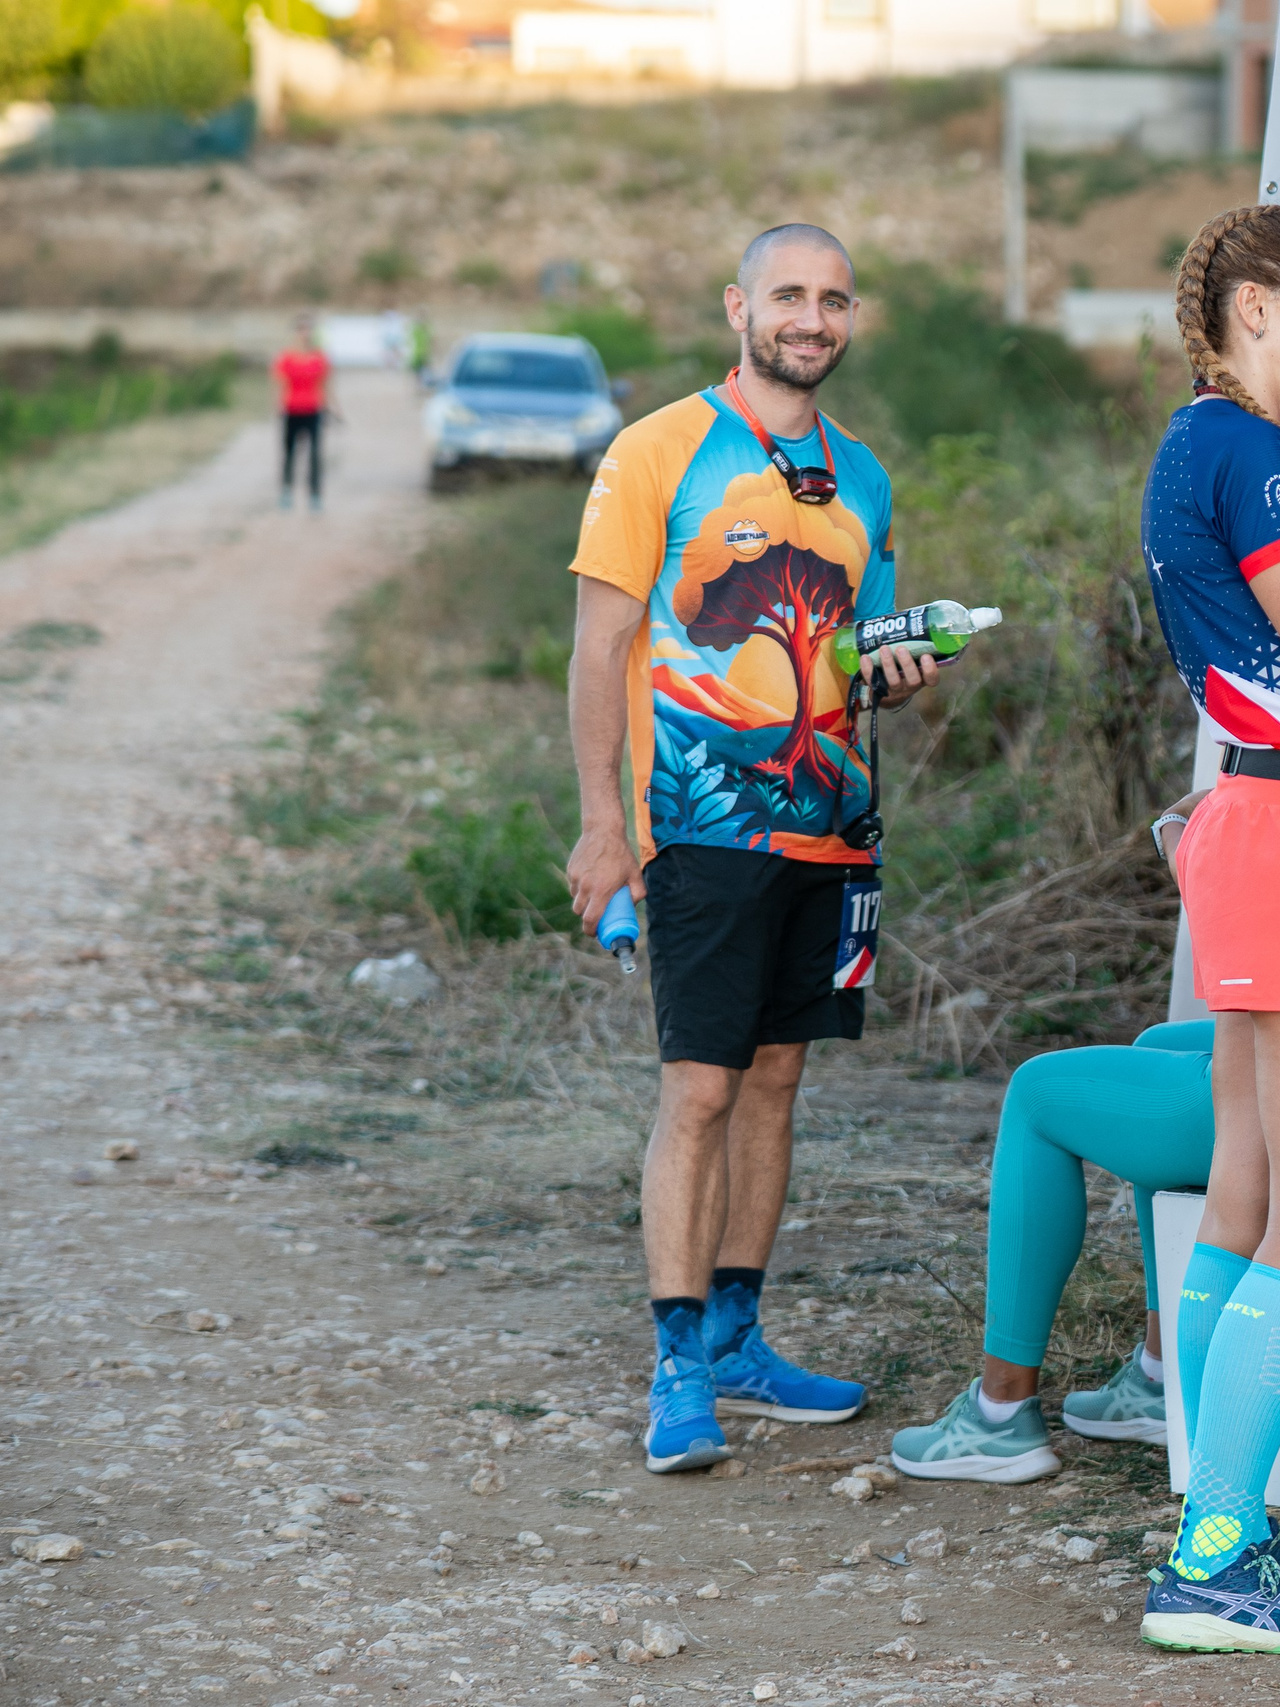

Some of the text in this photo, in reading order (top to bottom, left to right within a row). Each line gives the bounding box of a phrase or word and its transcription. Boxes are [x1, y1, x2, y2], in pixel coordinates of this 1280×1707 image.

[772, 452, 790, 472] PETZL
[1264, 492, 1273, 508] THE
[862, 616, 907, 639] 8000
[851, 890, 882, 933] 117
